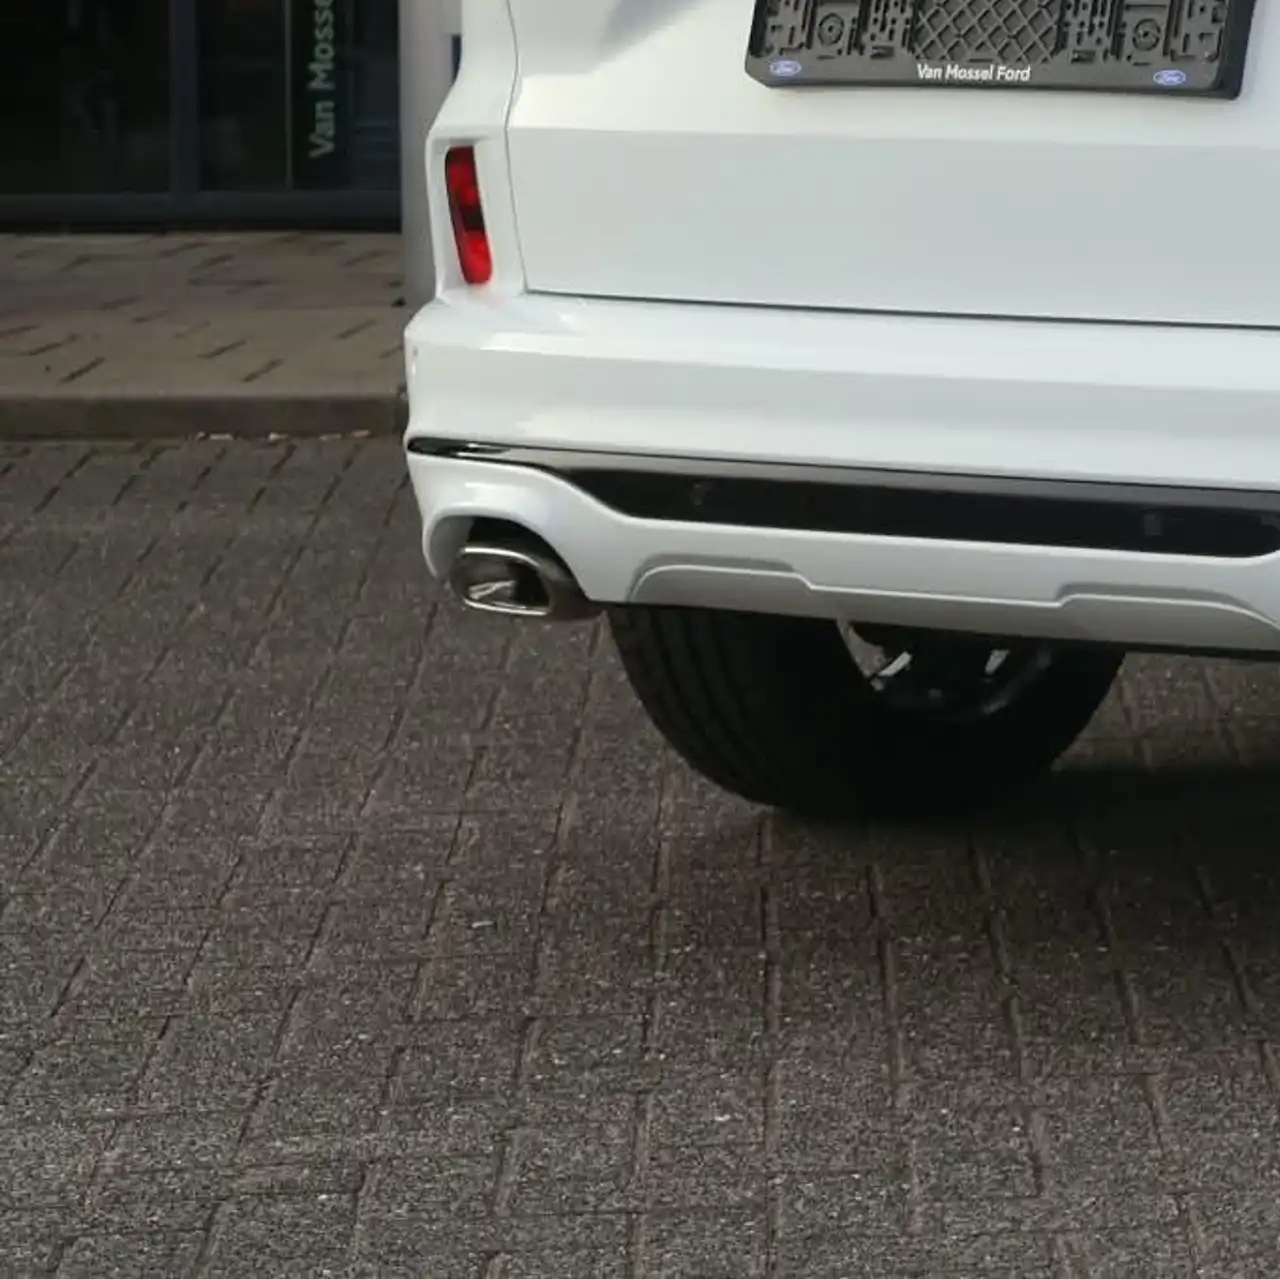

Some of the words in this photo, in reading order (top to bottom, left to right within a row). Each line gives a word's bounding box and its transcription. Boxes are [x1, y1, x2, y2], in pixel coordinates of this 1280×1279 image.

[916, 63, 941, 79] Van
[944, 63, 994, 81] Mossel
[996, 64, 1031, 82] Ford
[308, 101, 335, 159] Van
